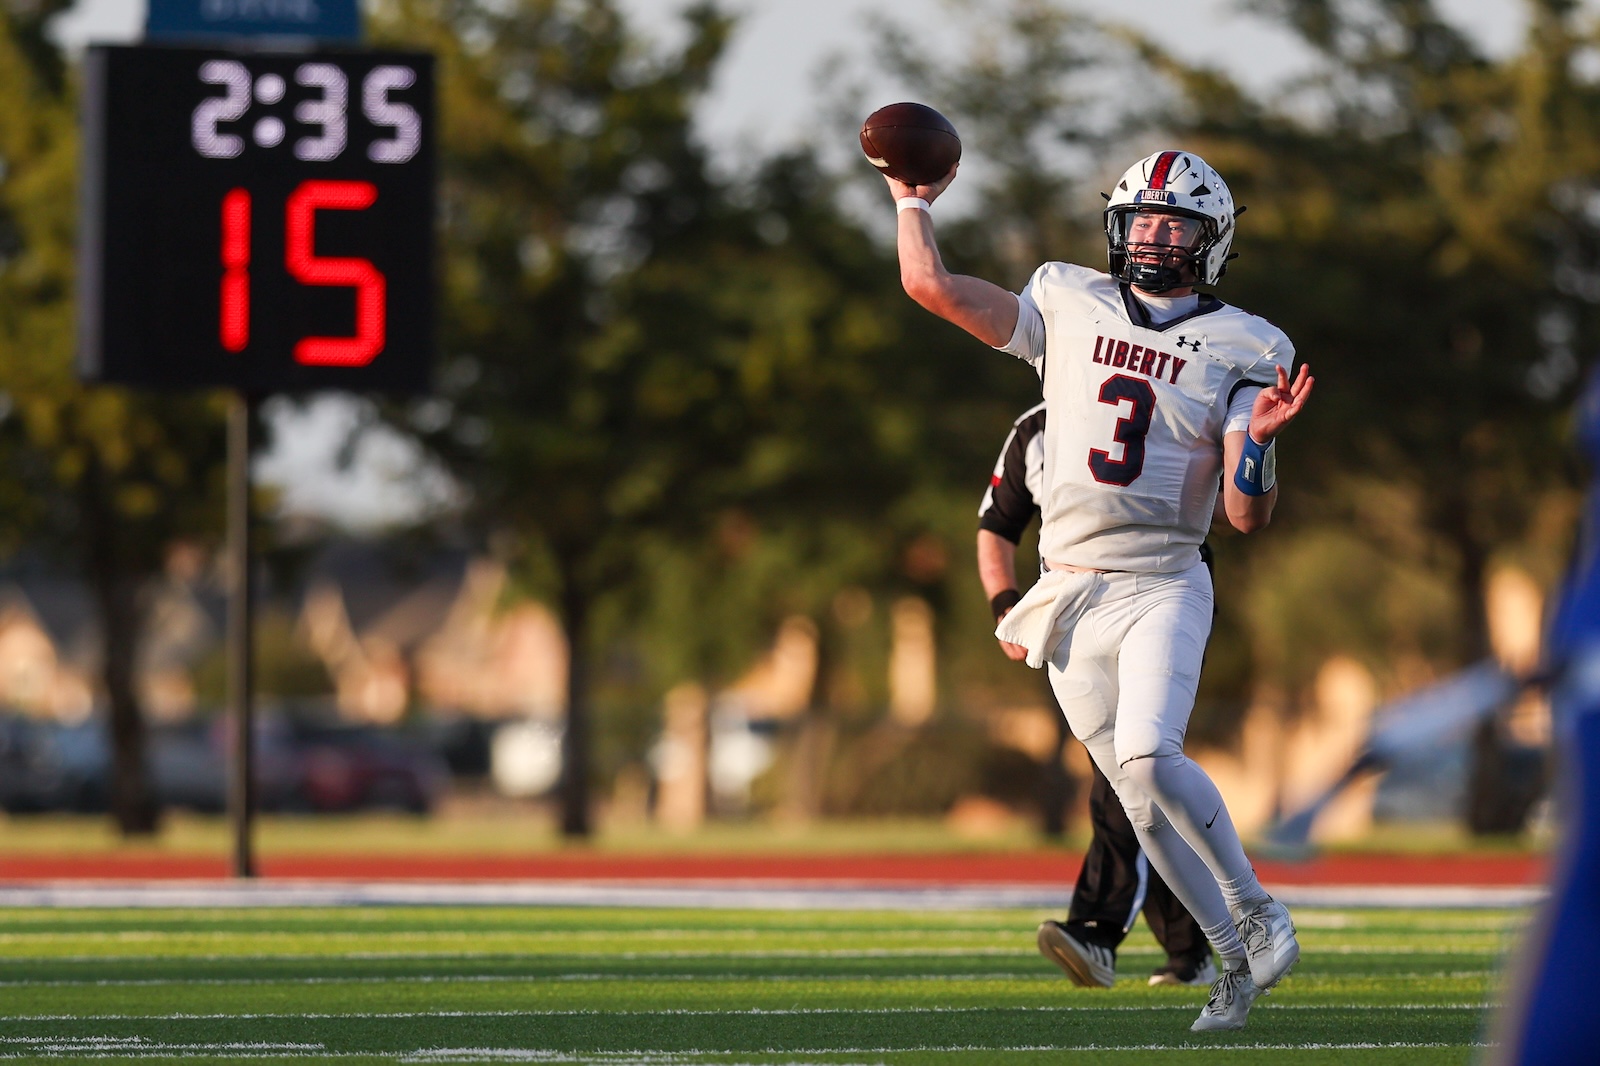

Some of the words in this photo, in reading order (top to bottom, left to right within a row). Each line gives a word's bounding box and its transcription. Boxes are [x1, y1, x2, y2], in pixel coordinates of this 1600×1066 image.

[191, 60, 421, 163] 2:35
[1141, 190, 1169, 201] LIBERTY
[220, 180, 386, 366] 15
[1092, 335, 1187, 385] LIBERTY
[1088, 373, 1157, 487] 3
